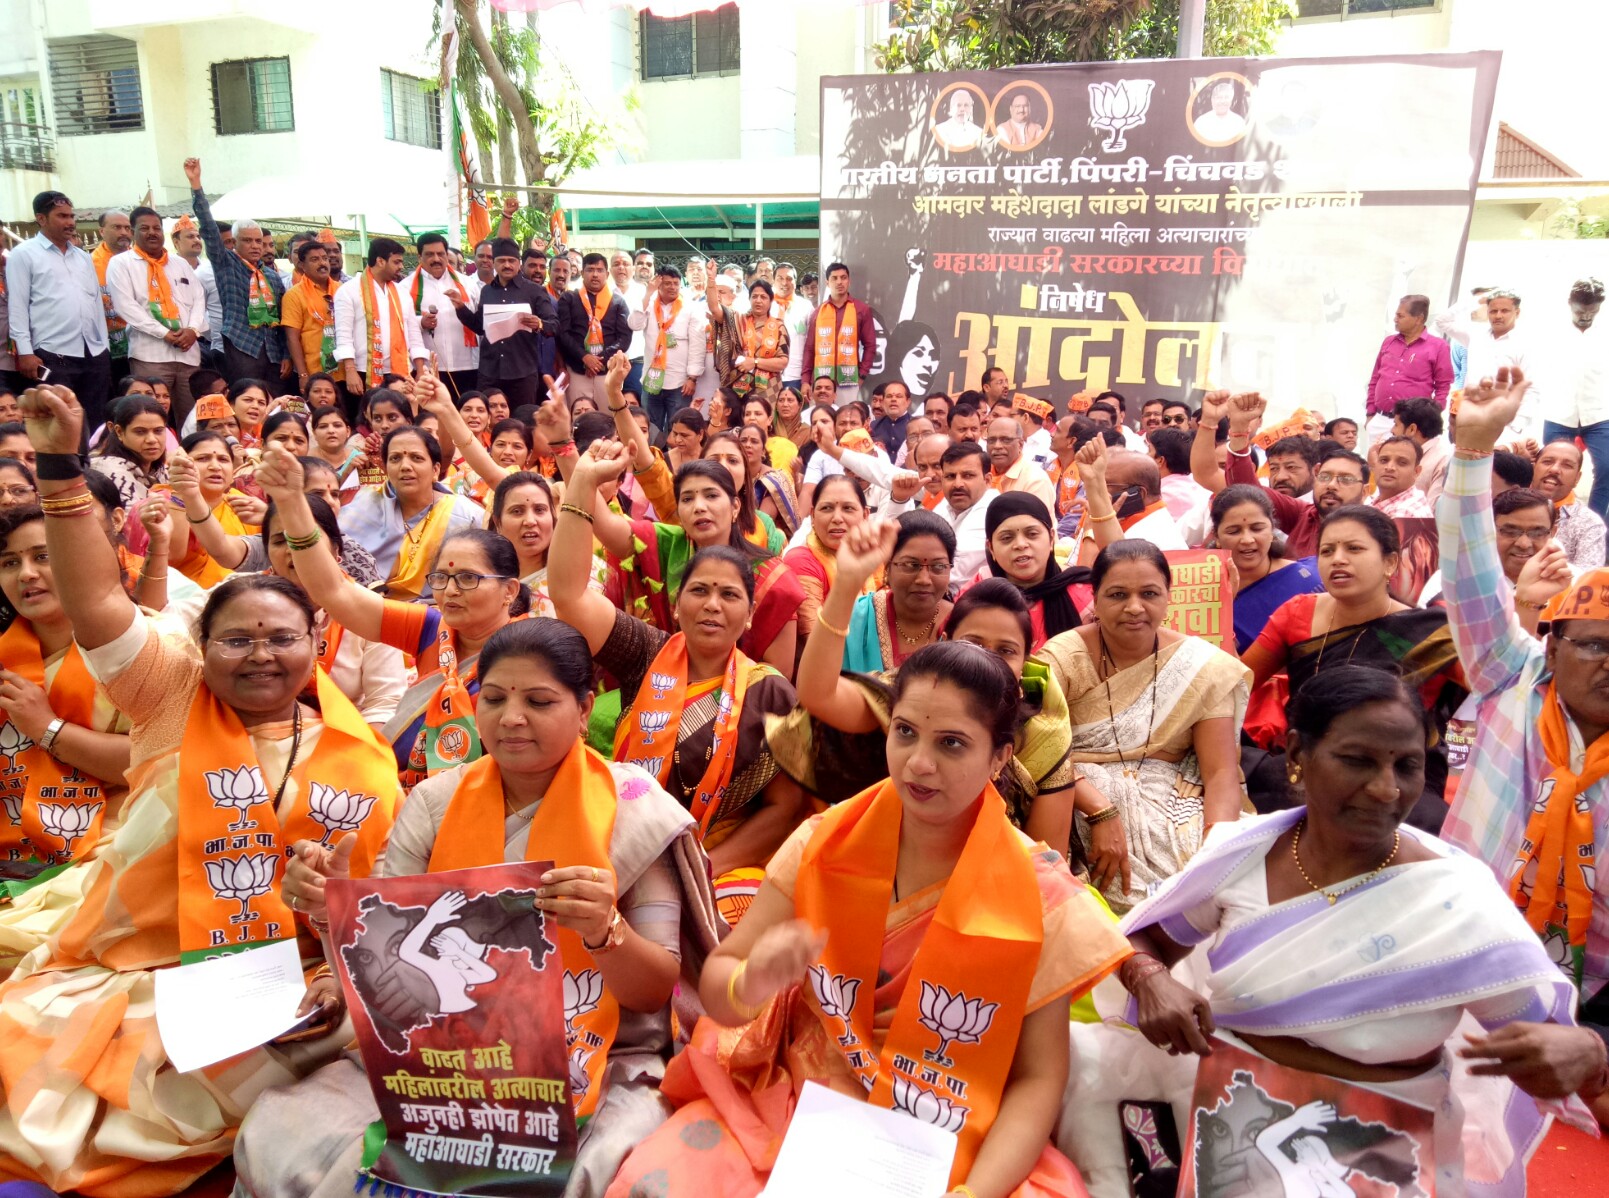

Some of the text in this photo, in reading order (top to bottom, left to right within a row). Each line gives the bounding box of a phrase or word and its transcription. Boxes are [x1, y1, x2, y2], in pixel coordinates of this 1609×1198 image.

[840, 161, 918, 187] ारतीय
[911, 195, 986, 219] आमदार
[991, 188, 1084, 219] महेशदादा
[1088, 187, 1150, 215] लांडगे
[1155, 187, 1220, 215] यांच्या
[987, 227, 1038, 244] राज्यात
[1042, 227, 1096, 245] वाढत्या
[1100, 221, 1151, 247] महिला
[932, 246, 1063, 275] महाआघाडी
[1069, 253, 1205, 275] सरकारच्या
[1039, 283, 1107, 314] निषेध
[472, 1039, 514, 1071] आहे
[490, 1077, 567, 1105] अत्याचार
[468, 1101, 520, 1134] झोपेत
[524, 1104, 559, 1143] आहे
[404, 1132, 557, 1175] महाआघाडी सरकार
